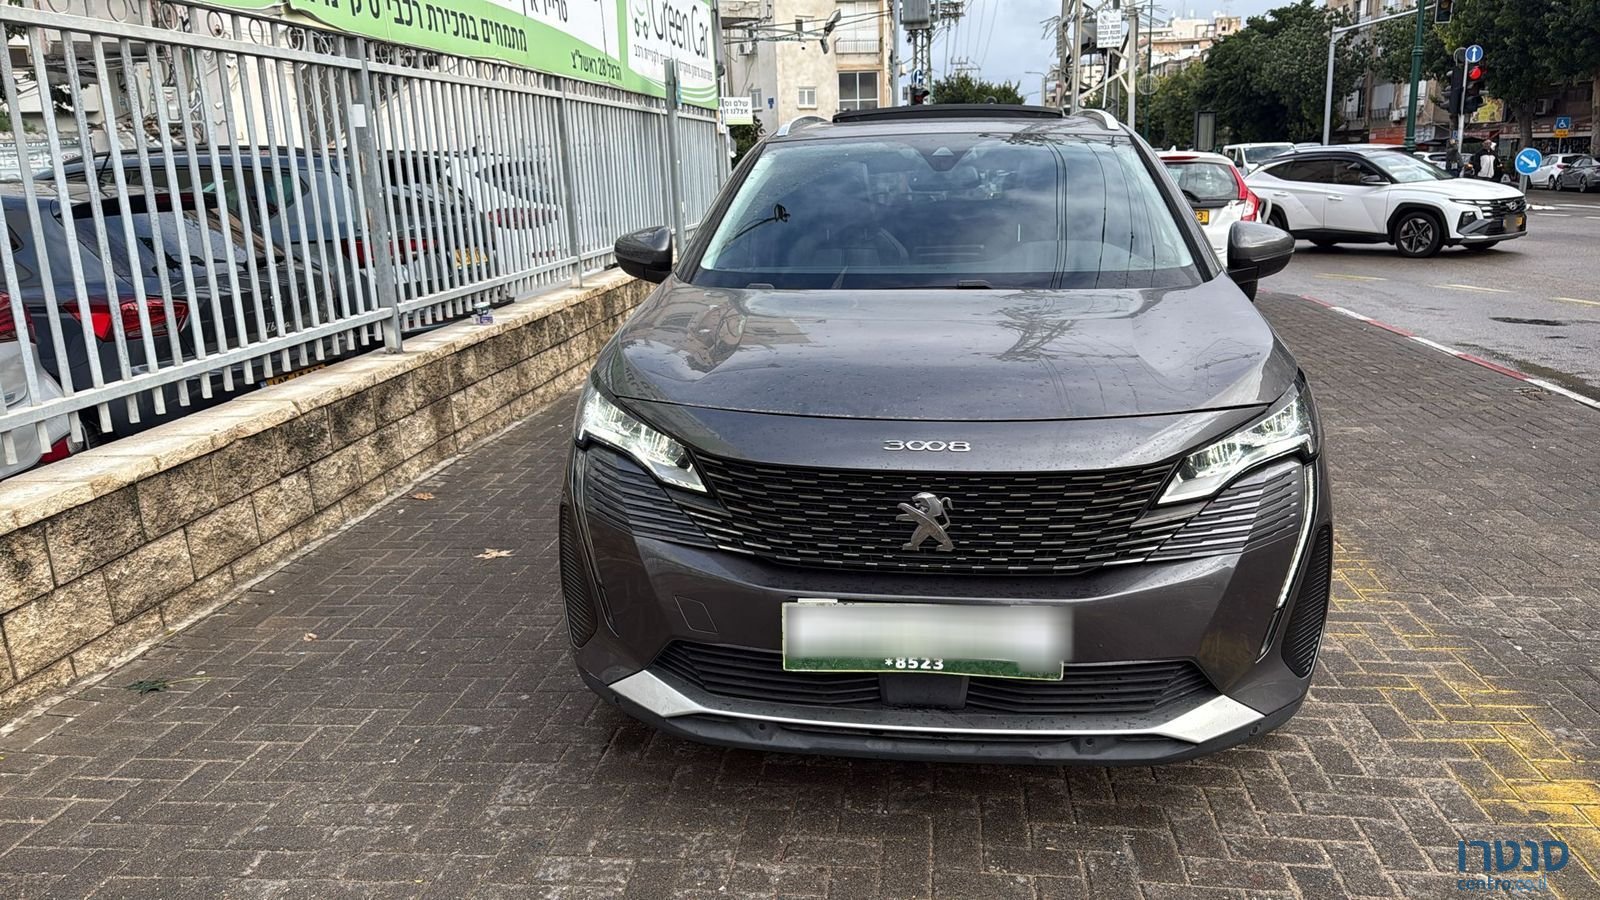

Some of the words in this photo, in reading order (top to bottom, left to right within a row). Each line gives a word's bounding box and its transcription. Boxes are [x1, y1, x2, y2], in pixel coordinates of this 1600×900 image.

[425, 3, 479, 41] במכירת
[480, 18, 528, 52] מתמחים
[651, 0, 691, 52] Green
[691, 5, 709, 60] Car
[733, 99, 749, 107] שלם
[730, 107, 749, 115] אצלנו
[266, 321, 291, 333] Iba
[882, 440, 972, 453] 3008
